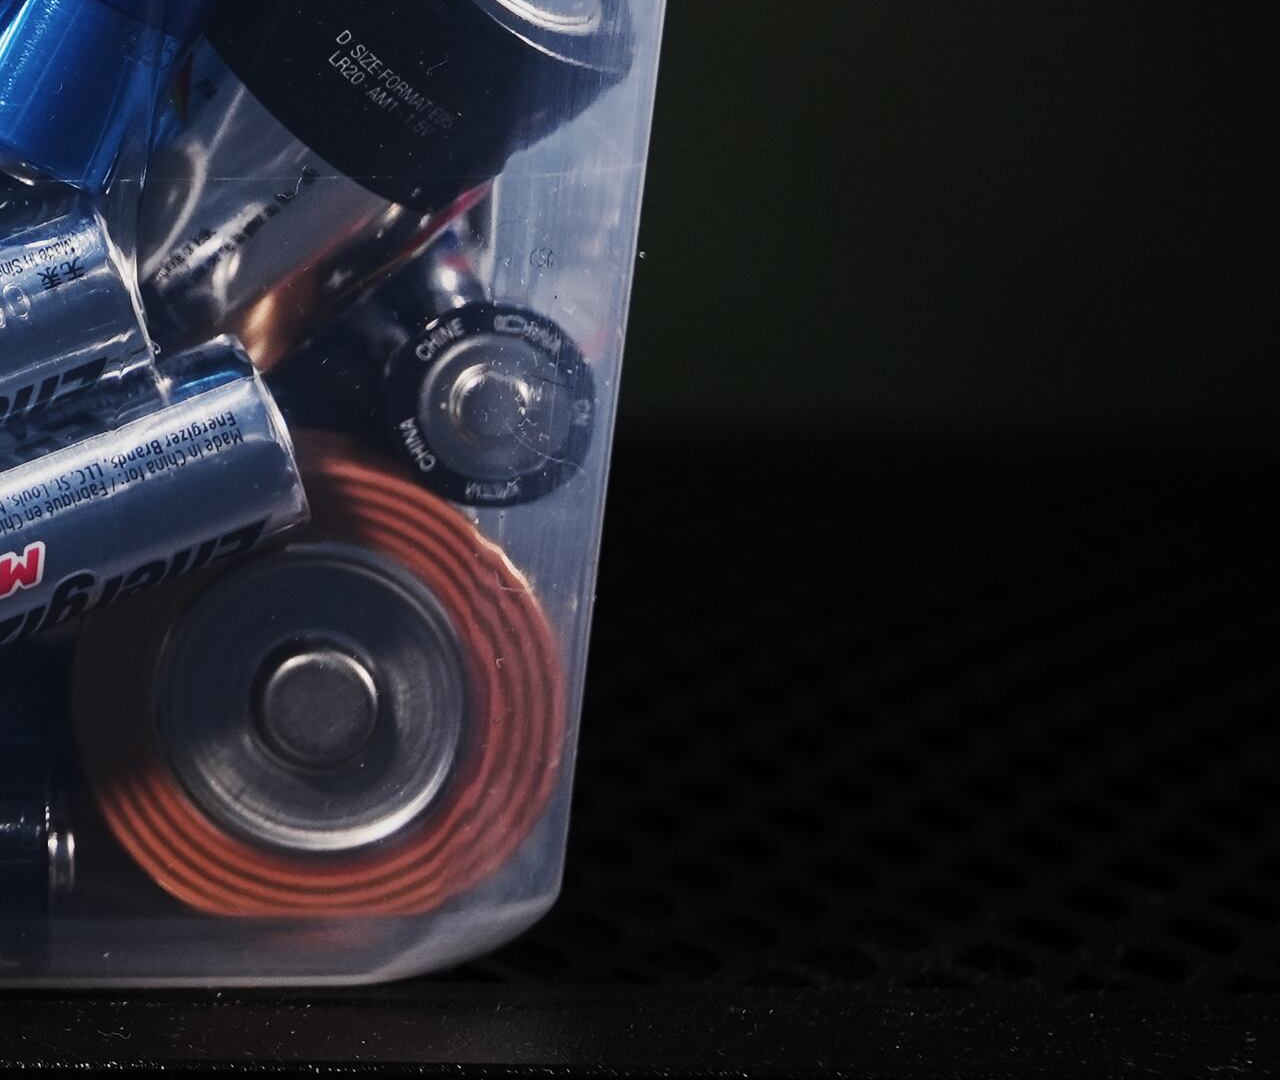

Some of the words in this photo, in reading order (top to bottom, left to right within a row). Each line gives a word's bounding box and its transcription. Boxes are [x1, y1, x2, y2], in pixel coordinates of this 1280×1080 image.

[334, 27, 353, 47] D
[326, 48, 367, 87] LR20
[184, 442, 203, 461] in
[202, 426, 244, 454] Made
[142, 447, 187, 478] China
[41, 478, 110, 519] Fabriqué
[21, 504, 43, 526] en
